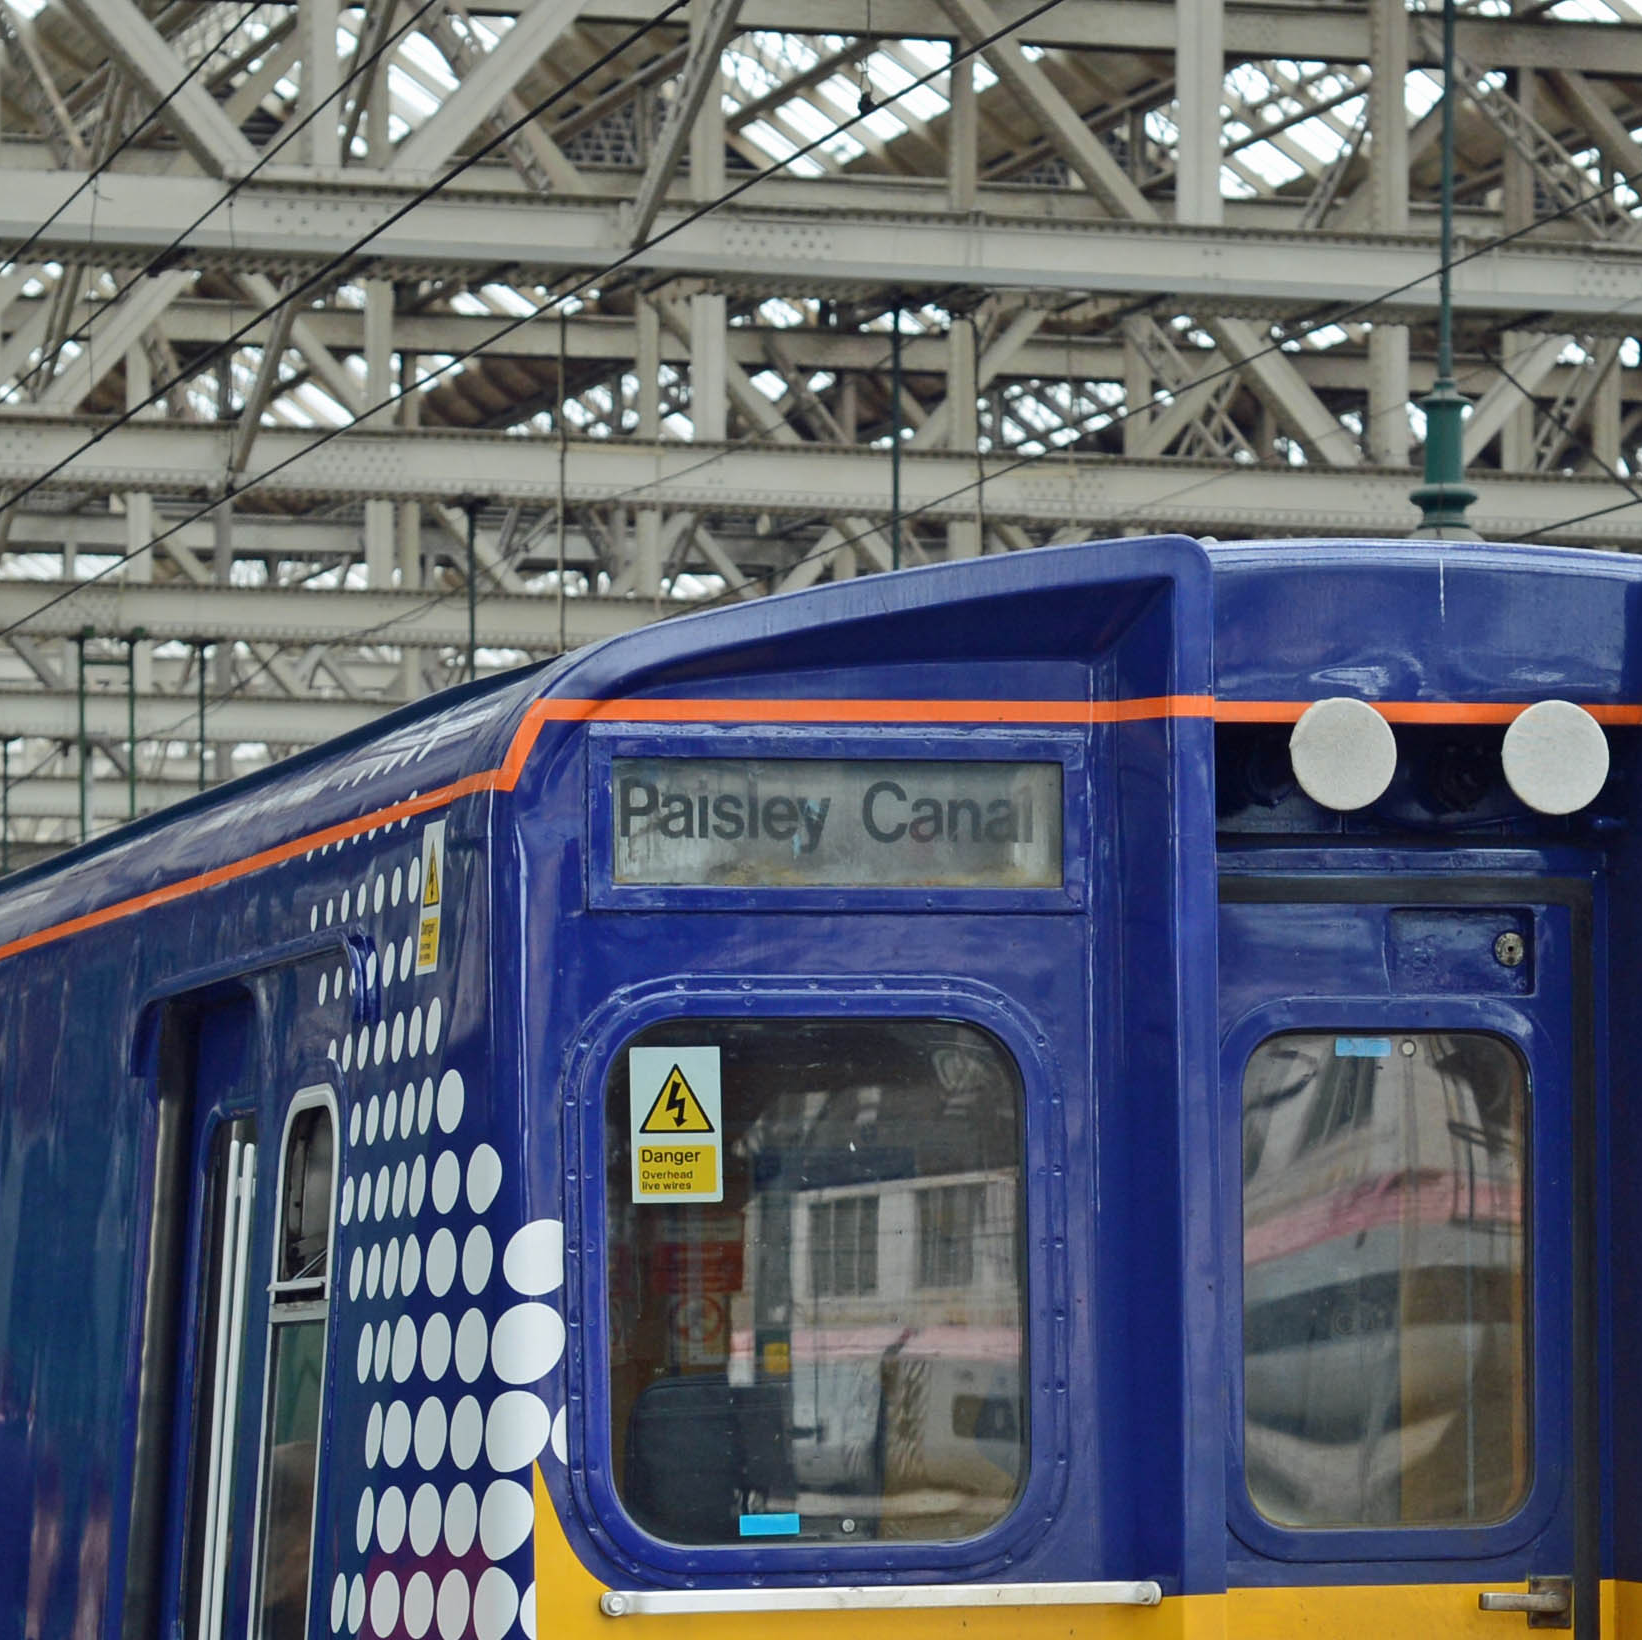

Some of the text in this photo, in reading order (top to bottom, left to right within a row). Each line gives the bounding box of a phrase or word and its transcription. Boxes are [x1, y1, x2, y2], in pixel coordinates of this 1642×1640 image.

[619, 778, 1034, 854] Paisley Canal
[641, 1149, 701, 1166] Danger
[642, 1170, 694, 1180] Overhead
[642, 1181, 692, 1190] live wires
